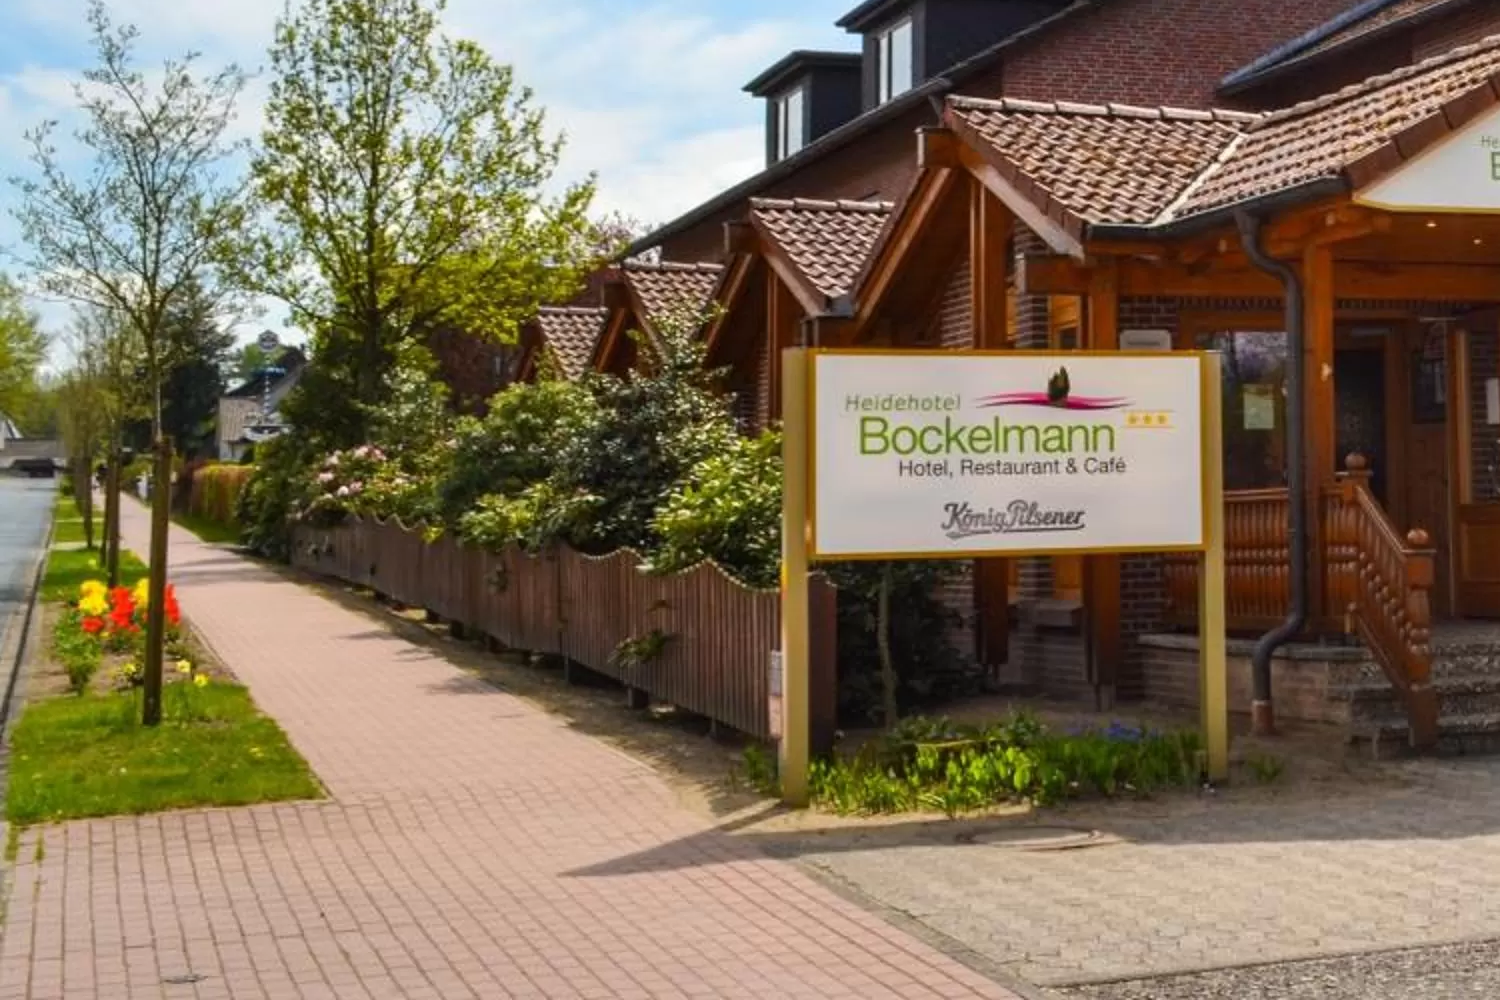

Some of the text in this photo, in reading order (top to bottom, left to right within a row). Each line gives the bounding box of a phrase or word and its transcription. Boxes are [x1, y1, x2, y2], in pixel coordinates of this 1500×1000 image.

[845, 394, 961, 412] Heidehotel
[859, 415, 1115, 455] Bockelmann
[899, 456, 1127, 478] Hotel, Restaurant & Café
